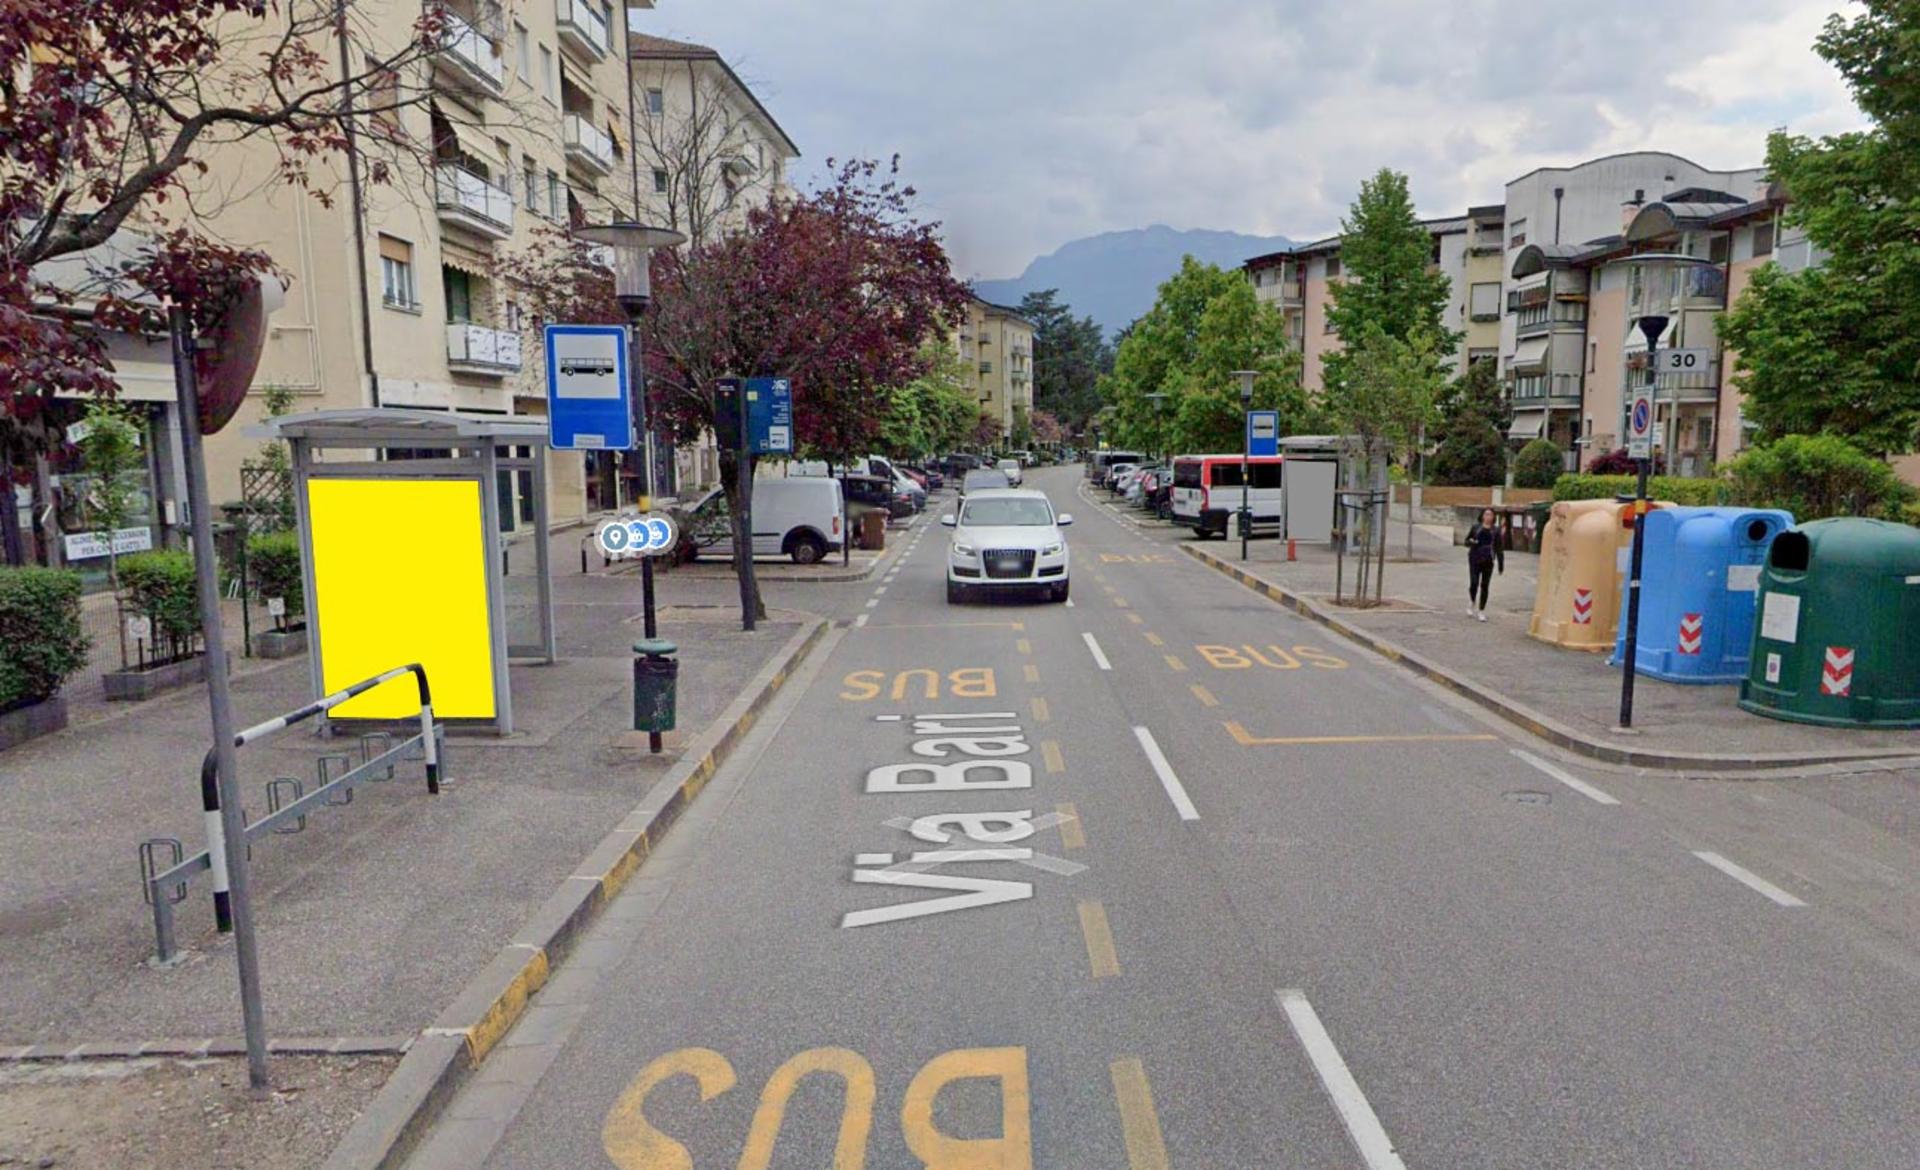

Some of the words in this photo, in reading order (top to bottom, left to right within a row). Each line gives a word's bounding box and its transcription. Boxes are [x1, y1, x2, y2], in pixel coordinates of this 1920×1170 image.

[1671, 353, 1696, 368] 30
[1196, 645, 1349, 669] BUS
[840, 667, 998, 702] BUS
